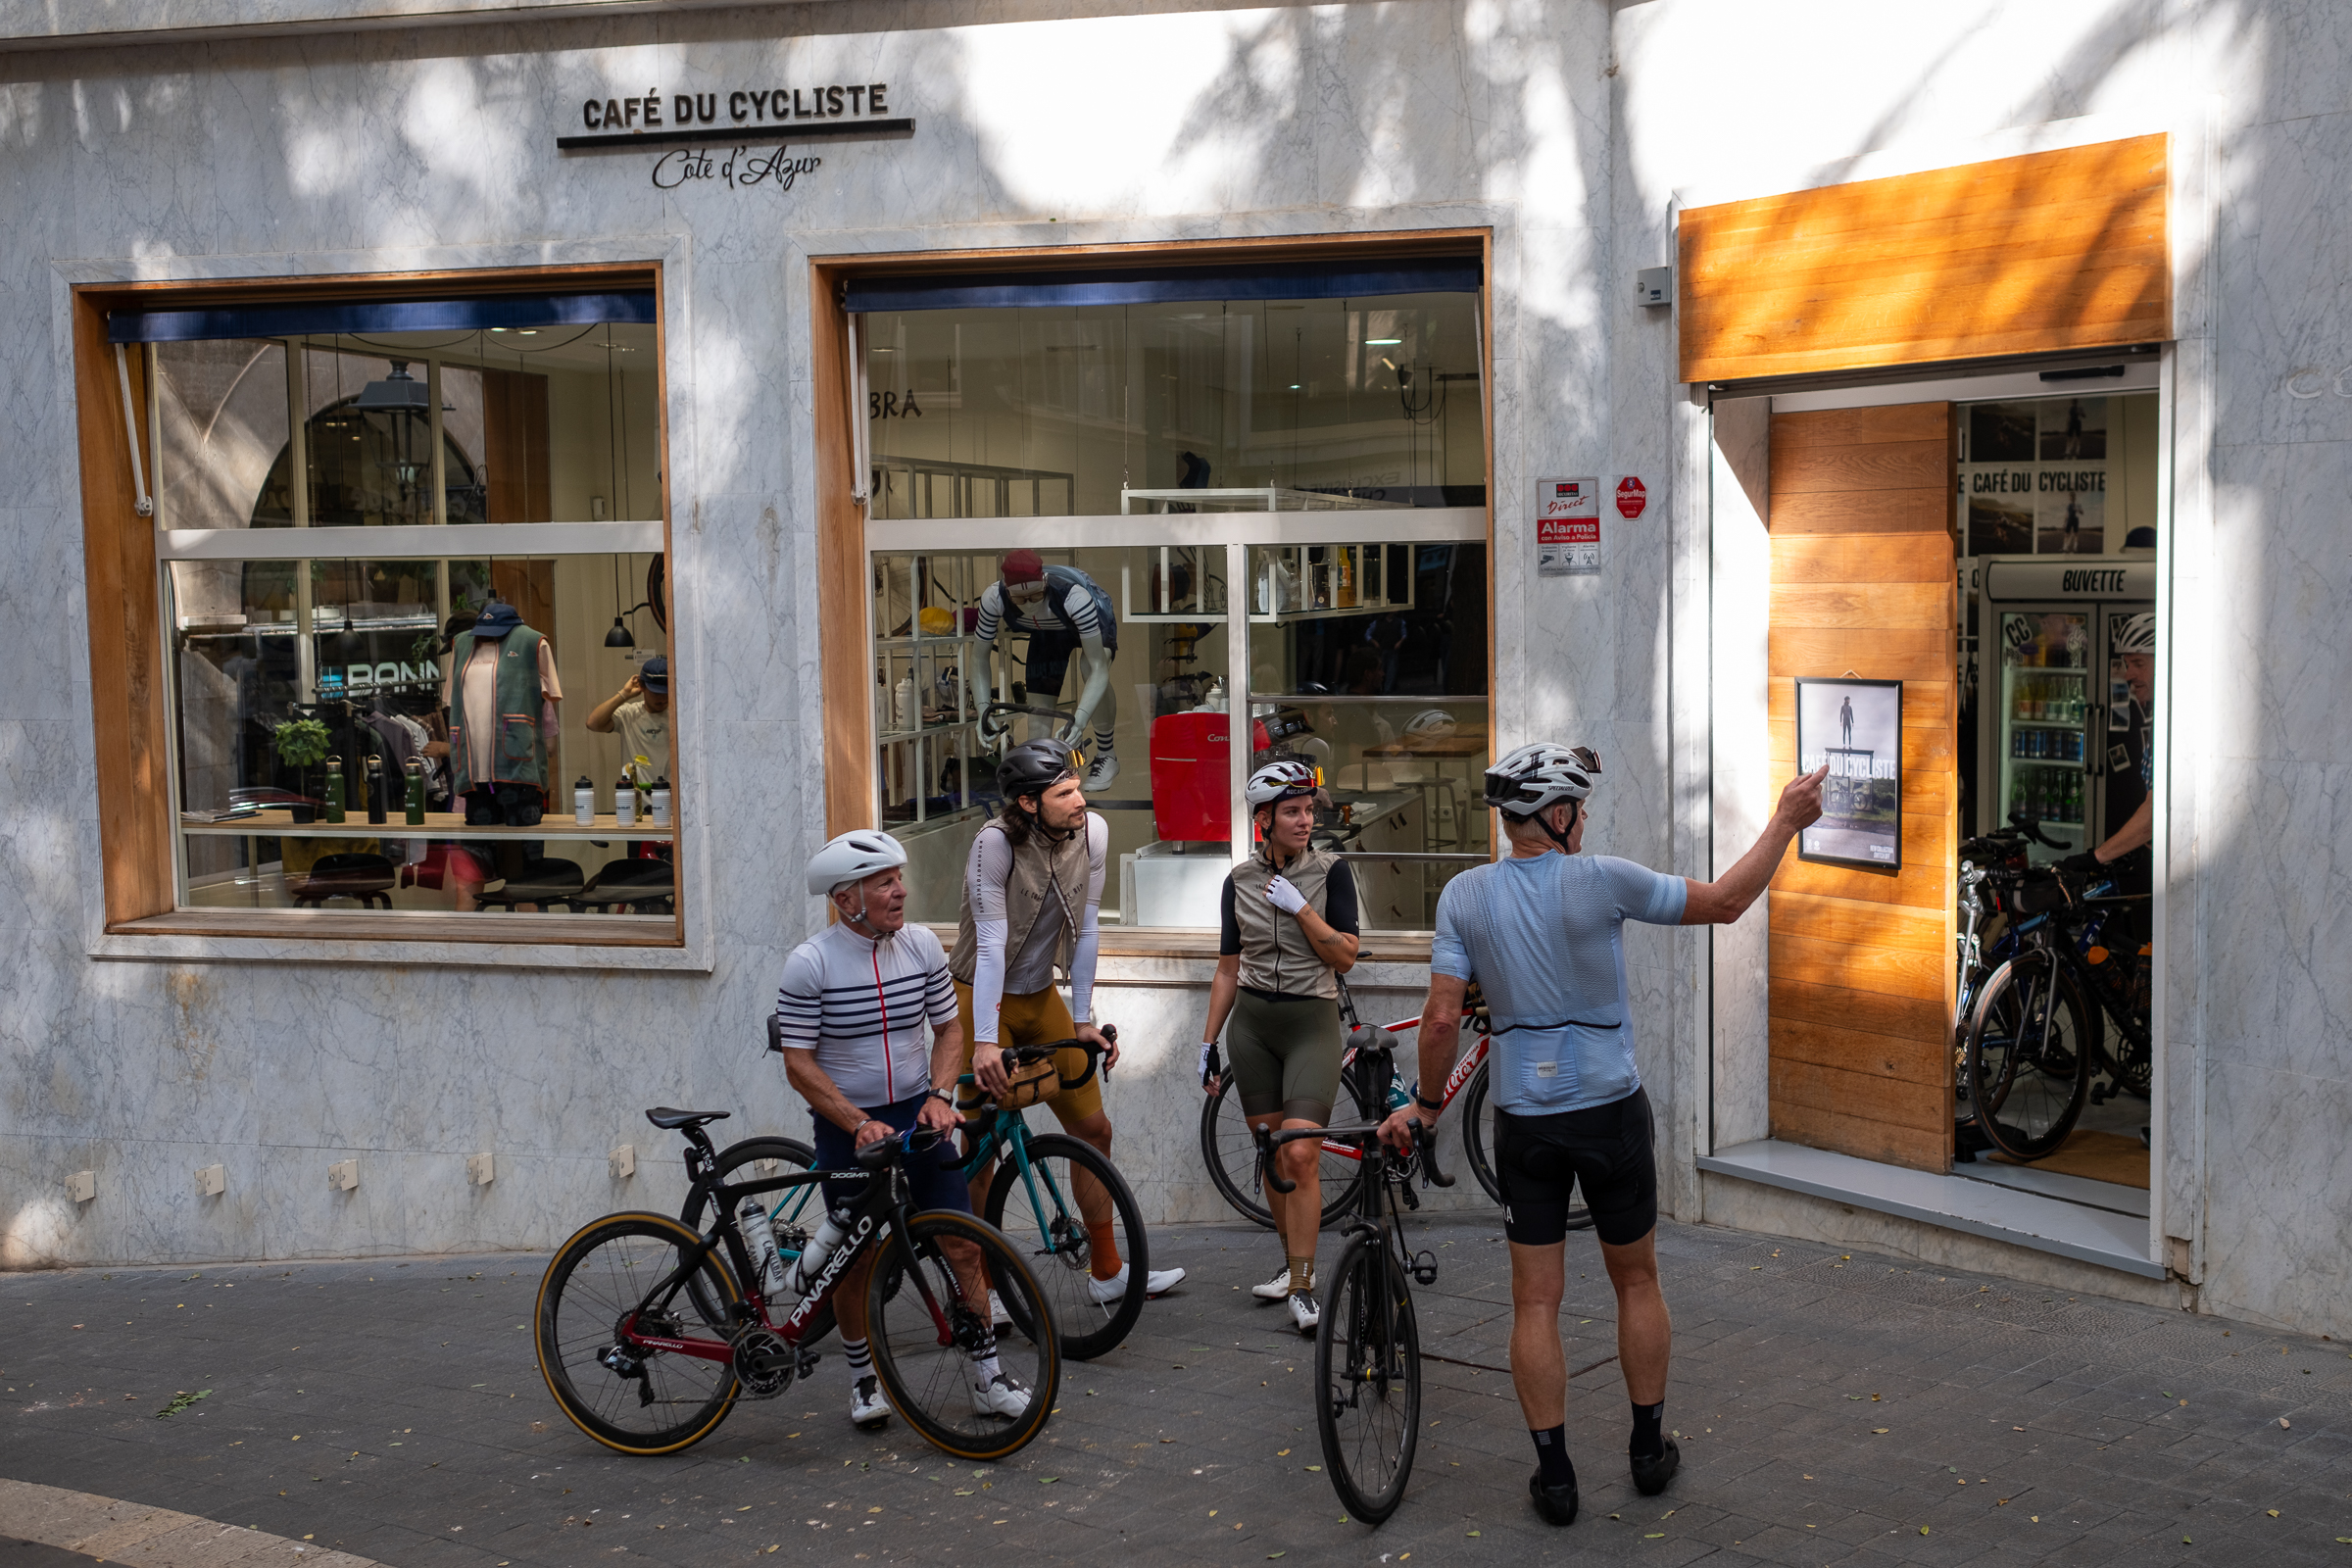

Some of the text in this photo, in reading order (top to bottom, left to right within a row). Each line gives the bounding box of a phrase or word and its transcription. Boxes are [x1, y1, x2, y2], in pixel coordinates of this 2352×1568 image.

[583, 83, 889, 128] CAFÉ DU CYCLISTE
[1973, 468, 2009, 493] CAFÉ
[2012, 472, 2032, 493] DU
[2038, 470, 2106, 492] CYCLISTE
[1546, 495, 1591, 515] Direct
[1541, 521, 1596, 534] Alarma
[2062, 569, 2127, 592] BUVETTE
[2005, 616, 2031, 647] CC
[1829, 756, 1843, 775] DU
[1846, 757, 1896, 780] CYCLISTE
[790, 1214, 873, 1328] PINARELLO
[642, 1339, 684, 1349] PINARELLO
